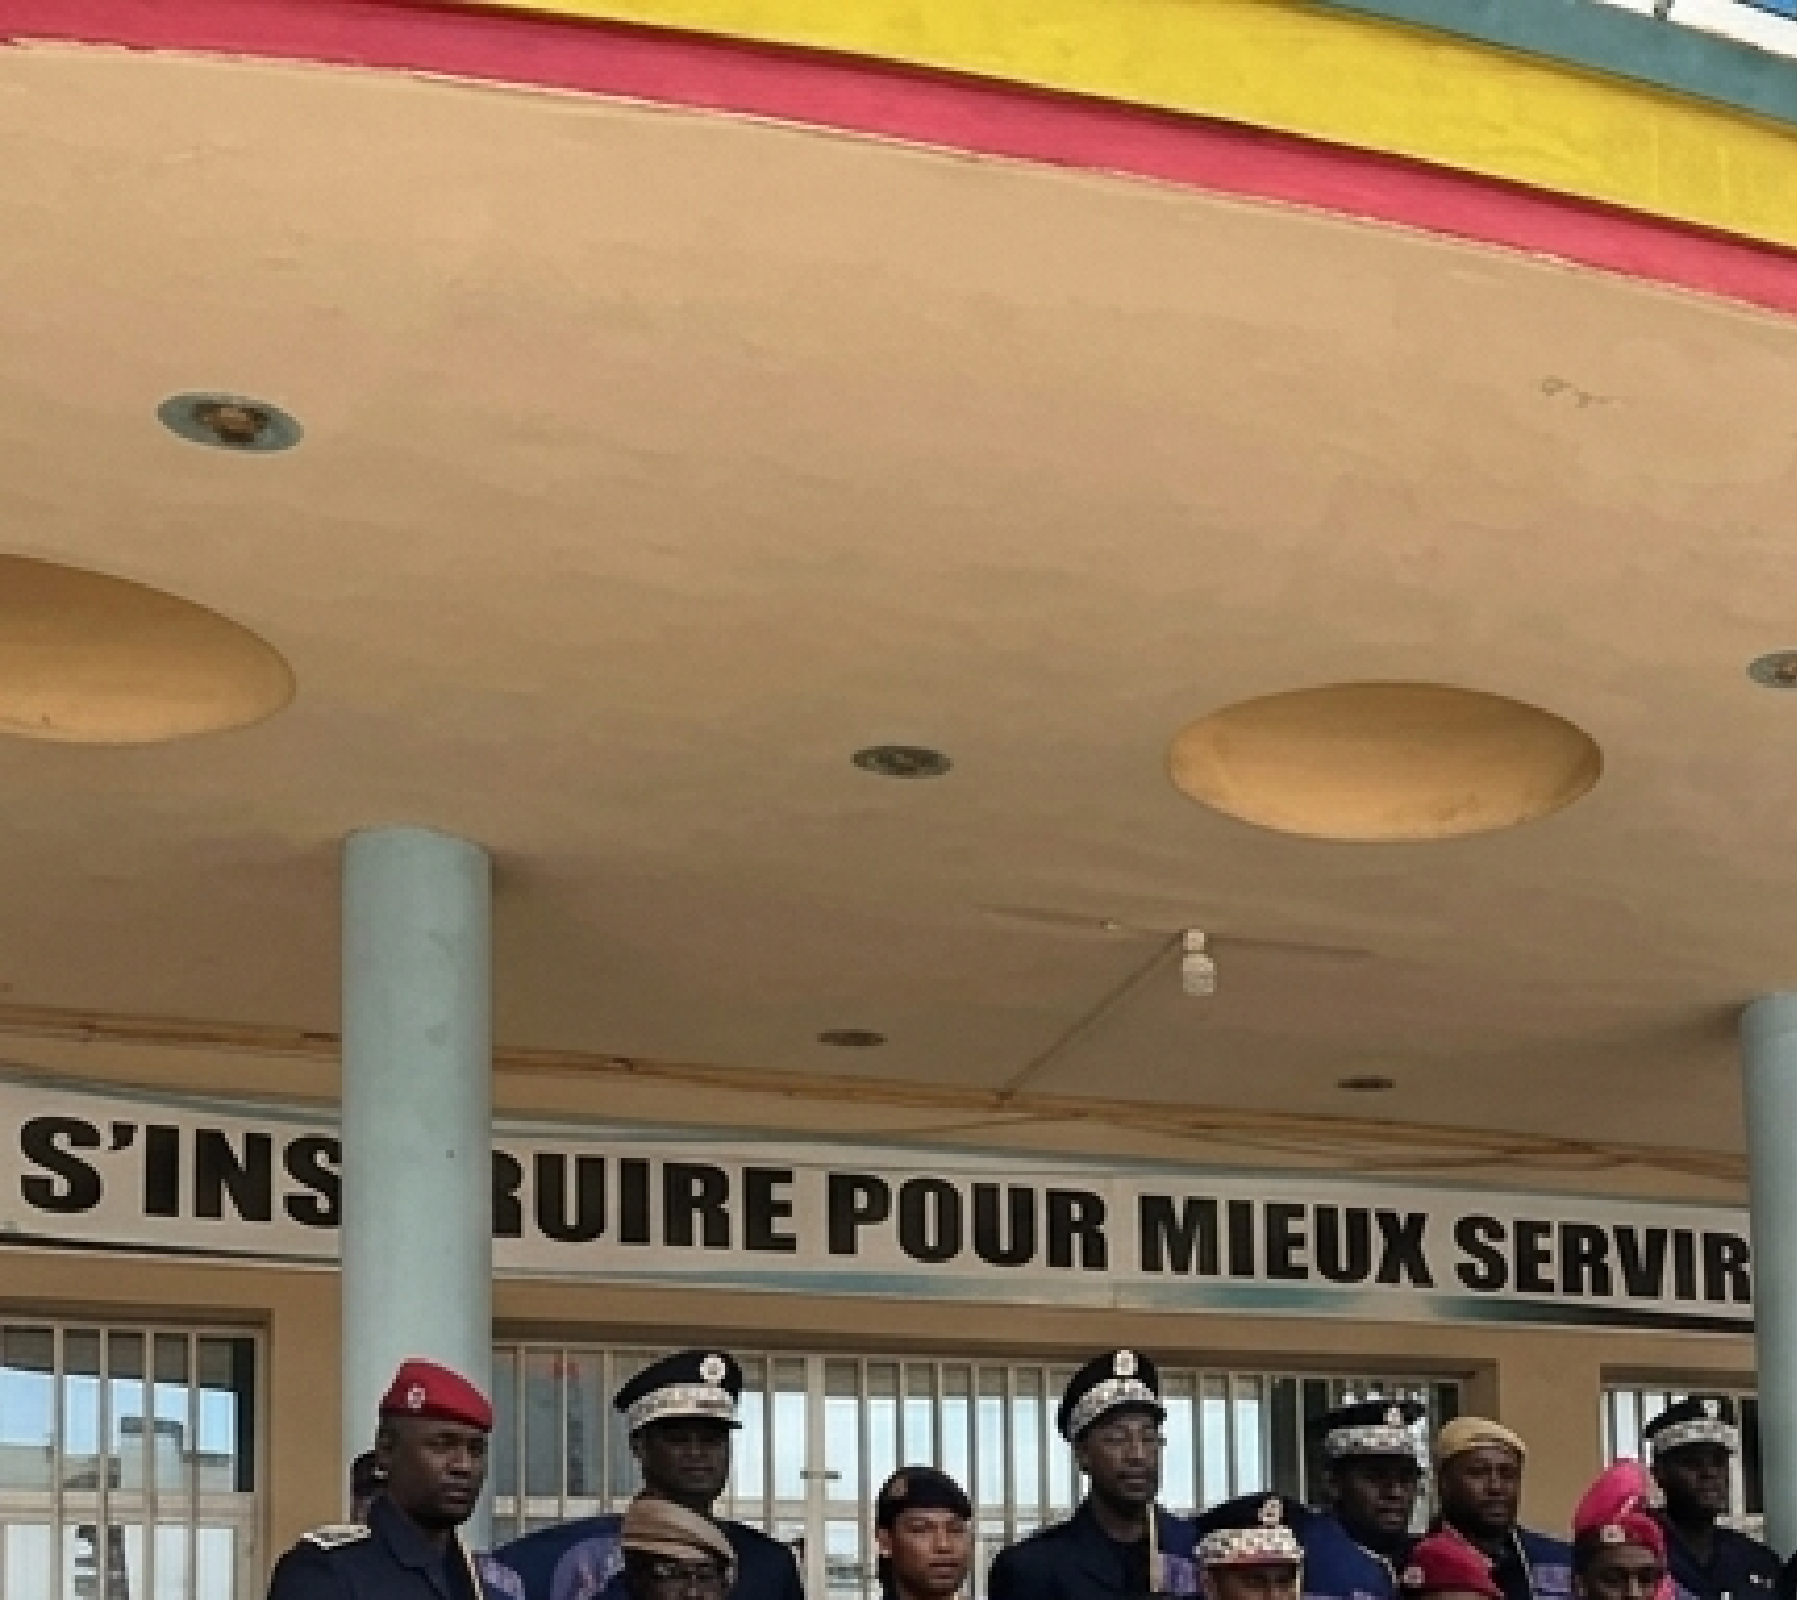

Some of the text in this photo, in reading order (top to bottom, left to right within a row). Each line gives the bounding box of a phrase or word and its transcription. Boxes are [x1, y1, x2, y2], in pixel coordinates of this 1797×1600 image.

[20, 1115, 1751, 1305] S'INSUIRE POUR MIEUX SERVIR
